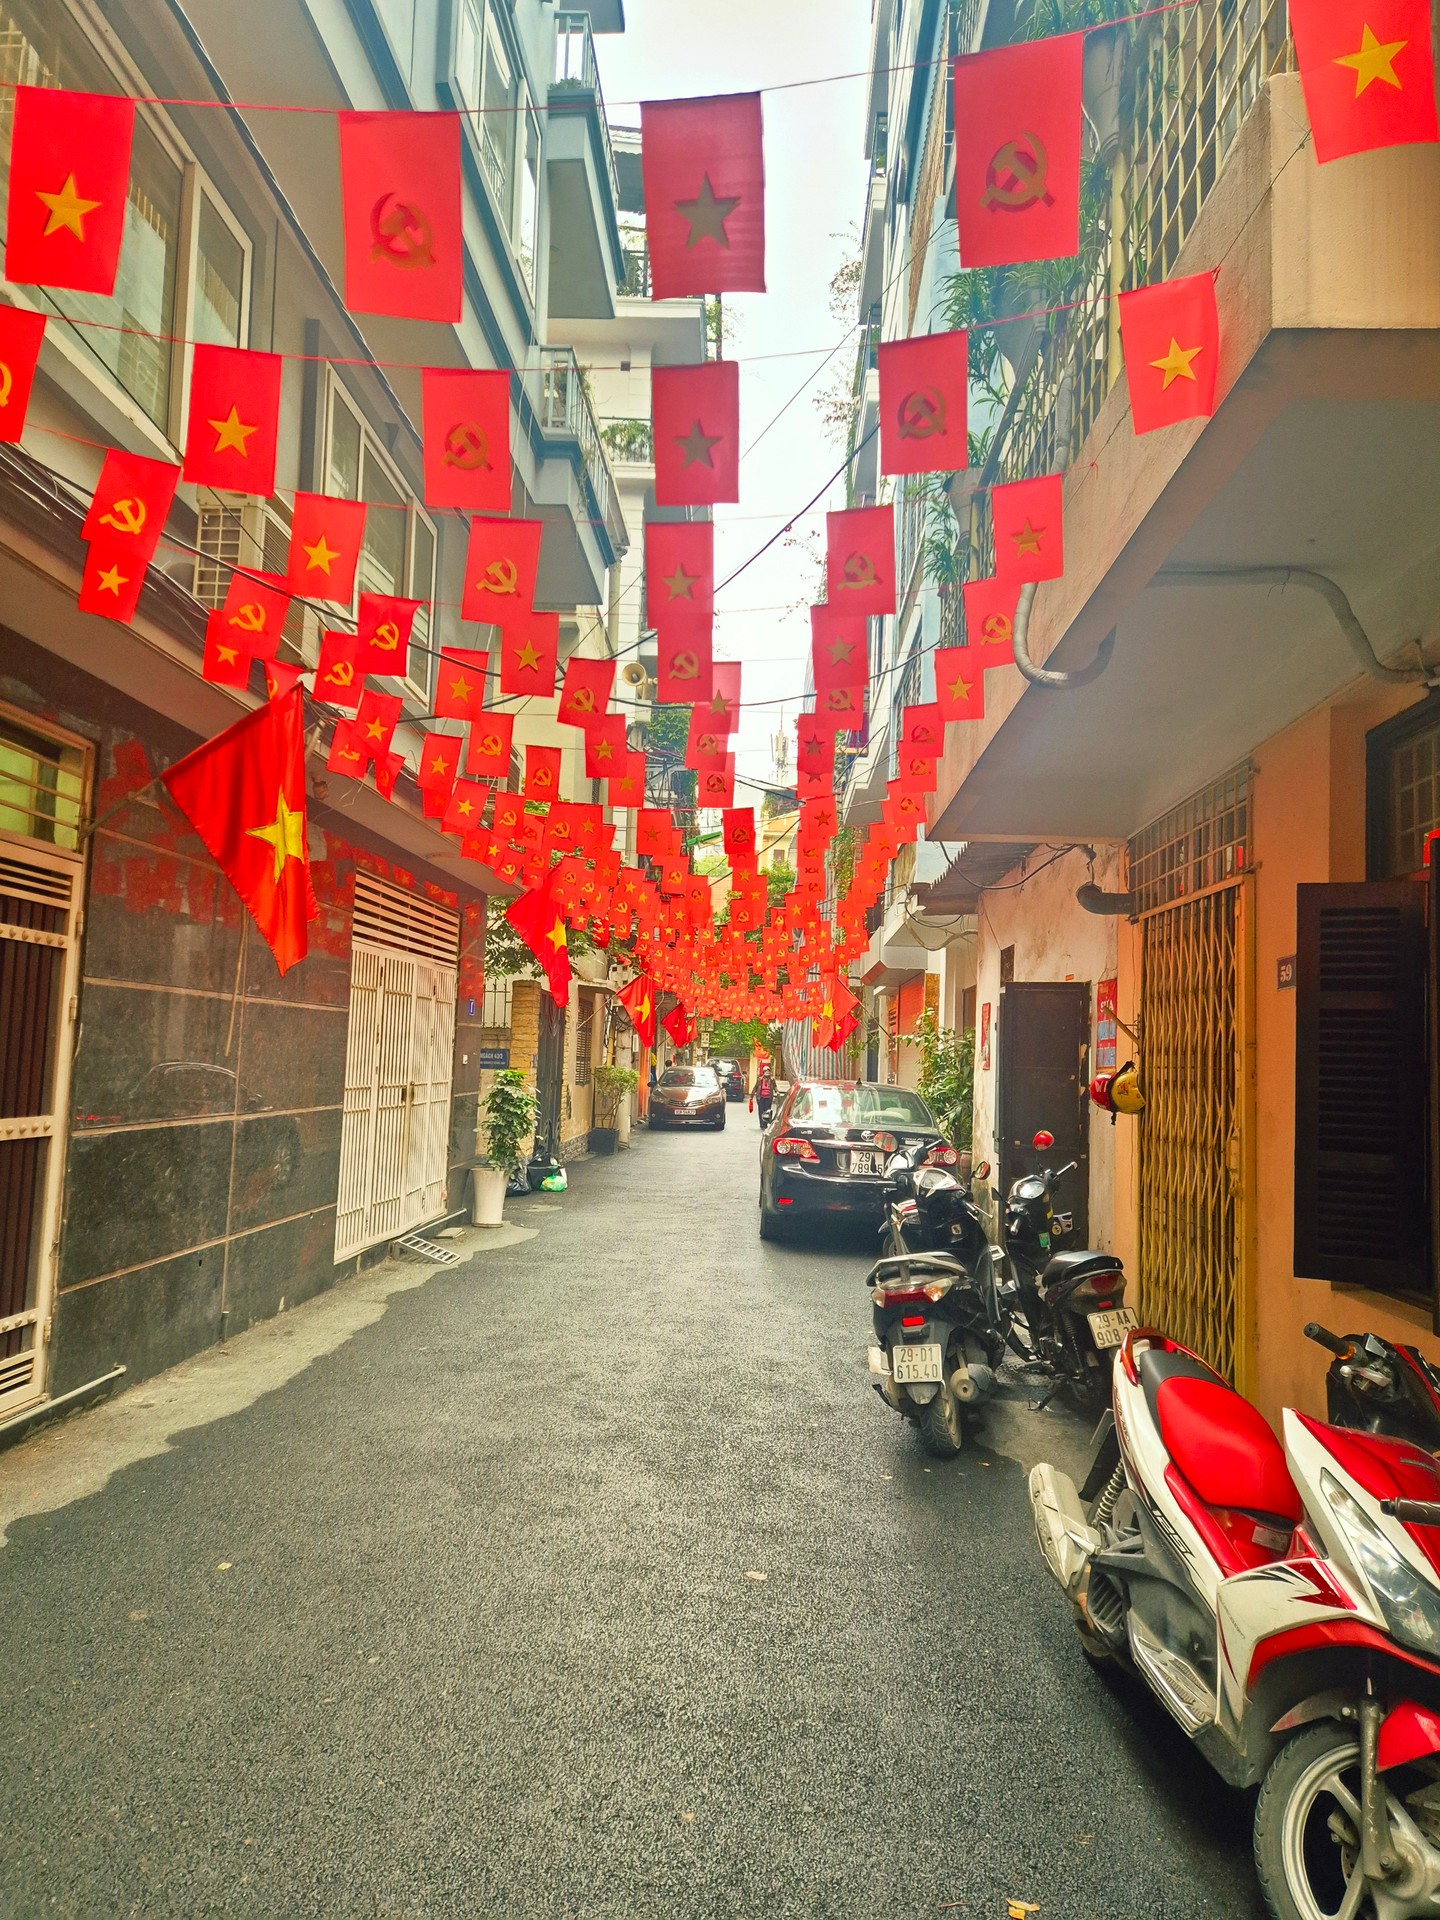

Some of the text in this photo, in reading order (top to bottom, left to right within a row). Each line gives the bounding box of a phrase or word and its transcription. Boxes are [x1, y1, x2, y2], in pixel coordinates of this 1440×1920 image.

[1280, 964, 1292, 982] 59
[859, 1151, 875, 1163] 29
[851, 1163, 883, 1174] 789.5
[900, 1347, 933, 1363] 29-D1
[897, 1363, 938, 1379] 615.40
